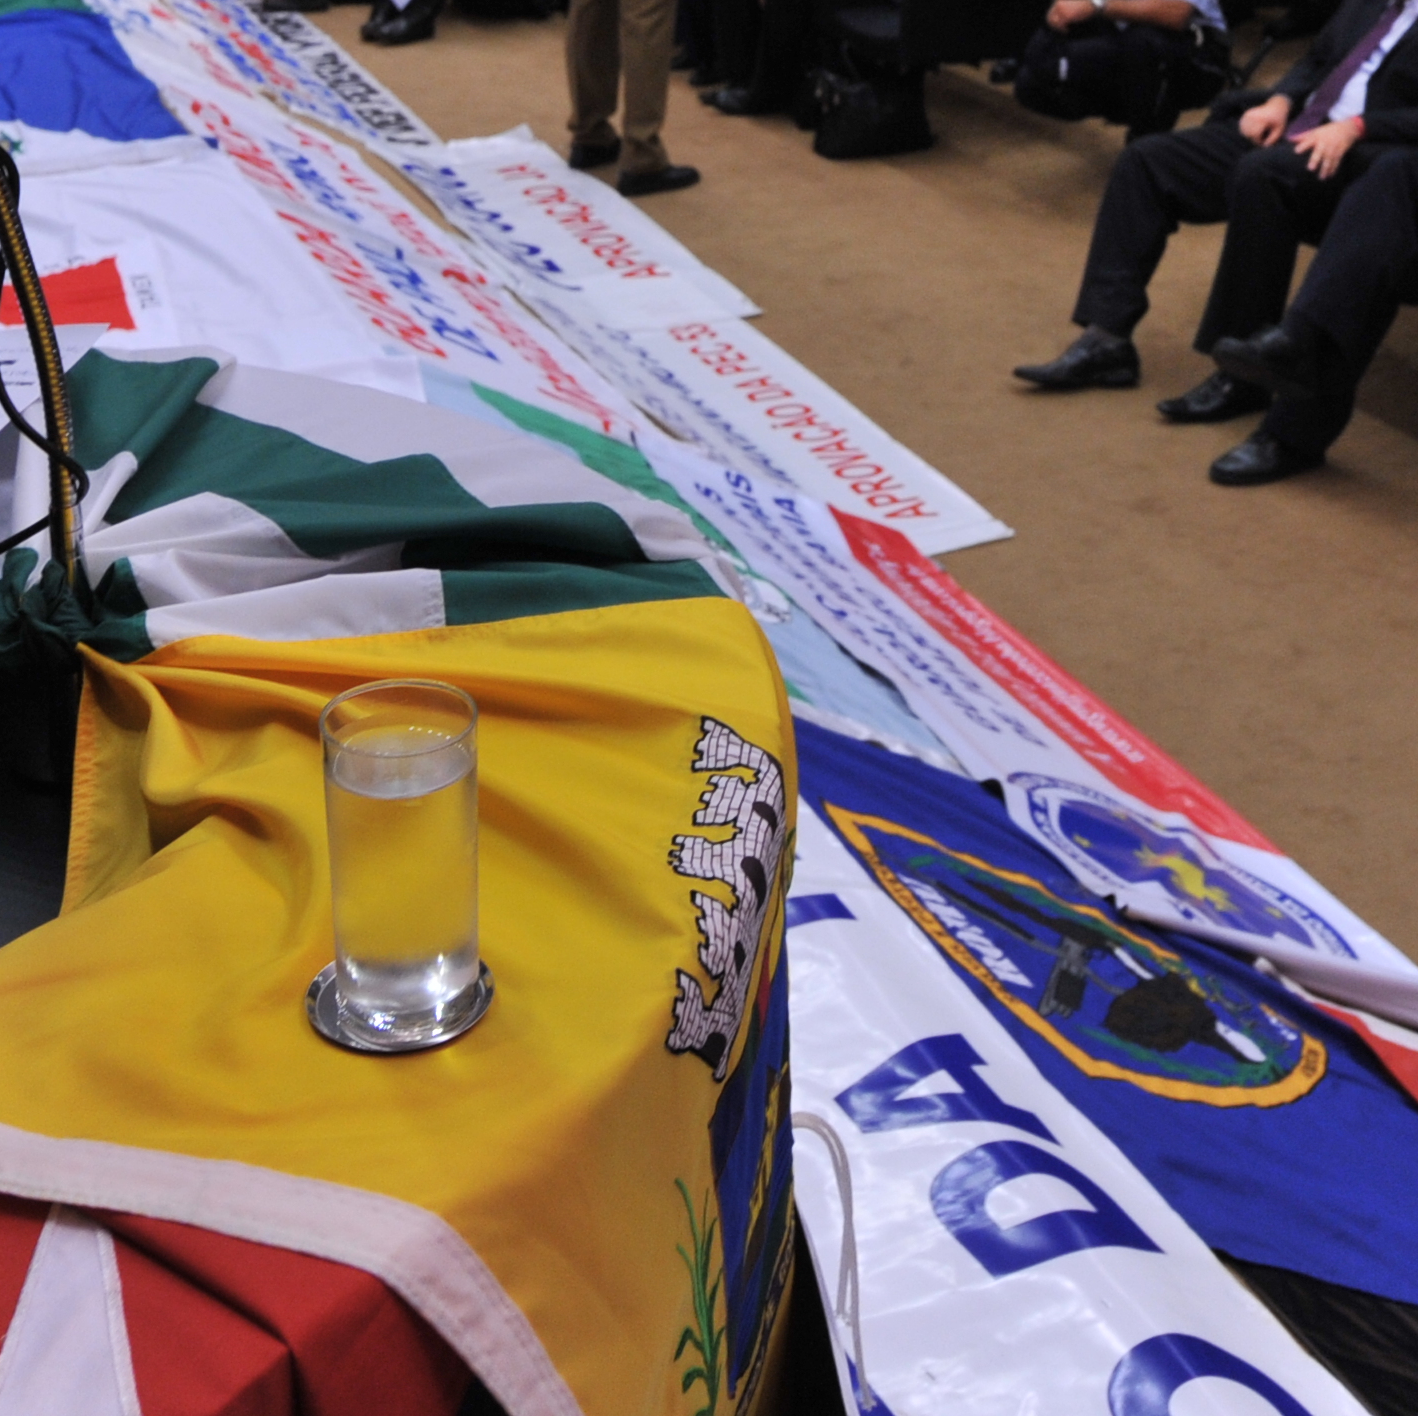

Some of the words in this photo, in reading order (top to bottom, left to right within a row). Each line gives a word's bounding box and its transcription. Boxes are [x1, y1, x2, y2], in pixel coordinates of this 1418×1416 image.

[689, 341, 761, 376] PEC
[734, 375, 795, 402] DA
[764, 402, 941, 519] APROVAÇÃO
[835, 1032, 1167, 1280] DA
